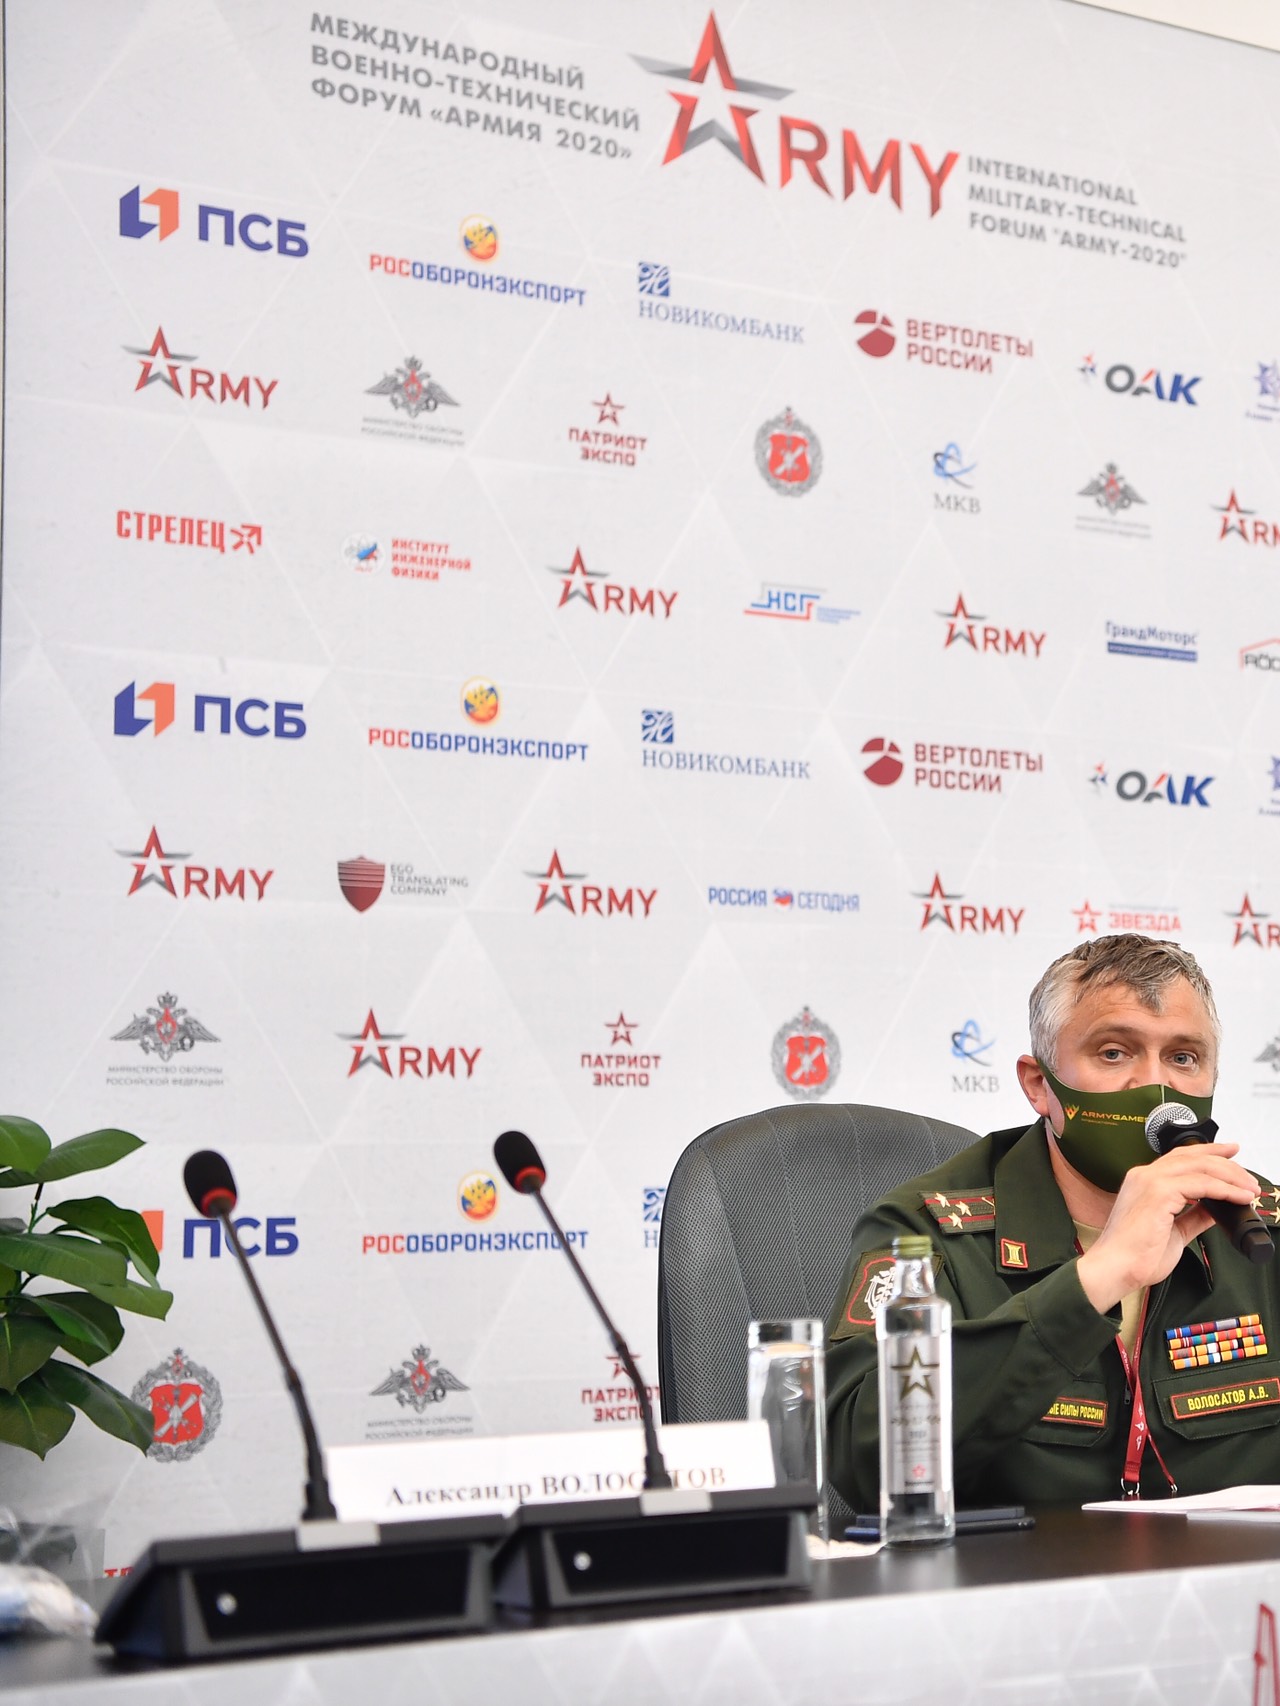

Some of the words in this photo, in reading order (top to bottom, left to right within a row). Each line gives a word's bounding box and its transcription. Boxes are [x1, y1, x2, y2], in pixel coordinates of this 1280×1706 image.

[310, 12, 585, 91] МЕЖДУНАРОДНЫЙ
[311, 45, 642, 131] ВОЕННО-ТЕХНИЧЕСКИЙ
[311, 77, 422, 118] ФОРУМ
[431, 104, 542, 143] «АРМИЯ
[555, 128, 634, 160] 2020»
[968, 155, 1138, 206] INTERNATIONAL
[968, 184, 1186, 243] MILITARY-TECHNICAL
[969, 212, 1046, 243] FORUM
[198, 204, 309, 258] ПСБ
[369, 253, 587, 307] РОСОБОРОНЭКСПОРТ
[639, 301, 805, 345] НОВИКОМБАНК
[906, 318, 1034, 358] ВЕРТОЛЕТЫ
[906, 343, 993, 374] РОССИИ
[1105, 364, 1202, 406] ОАК
[568, 427, 647, 452] ПАТРИОТ
[580, 446, 637, 467] ЭКСПО
[116, 509, 227, 553] СТРЕЛЕЦ
[391, 539, 449, 554] ИНСТИТУТ
[391, 553, 471, 571] ИНЖЕНЕРНОЙ
[1106, 620, 1197, 645] ГрандМоторс
[194, 694, 307, 740] ПСБ
[368, 727, 589, 762] РОСОБОРОНЭКСПОРТ
[914, 743, 1044, 773] ВЕРТОЛЕТЫ
[641, 747, 810, 780] НОВИКОМБАНК
[914, 768, 1002, 793] РОССИИ
[1116, 770, 1215, 807] ОАК
[709, 887, 767, 906] РОССИЯ
[798, 891, 859, 911] СЕГОДНЯ
[1108, 911, 1182, 932] ЗВЕЗДА
[581, 1054, 661, 1070] ПАТРИОТ
[592, 1073, 650, 1088] ЭКСПО
[183, 1217, 299, 1258] ПСБ
[1060, 1403, 1079, 1416] СИЛЫ
[1080, 1404, 1103, 1420] РОССИИ
[1187, 1389, 1246, 1411] ВОЛОСАТОВ
[1249, 1386, 1269, 1401] А.В.
[386, 1483, 531, 1508] Александр
[541, 1467, 726, 1497] ВОЛОСТОВ
